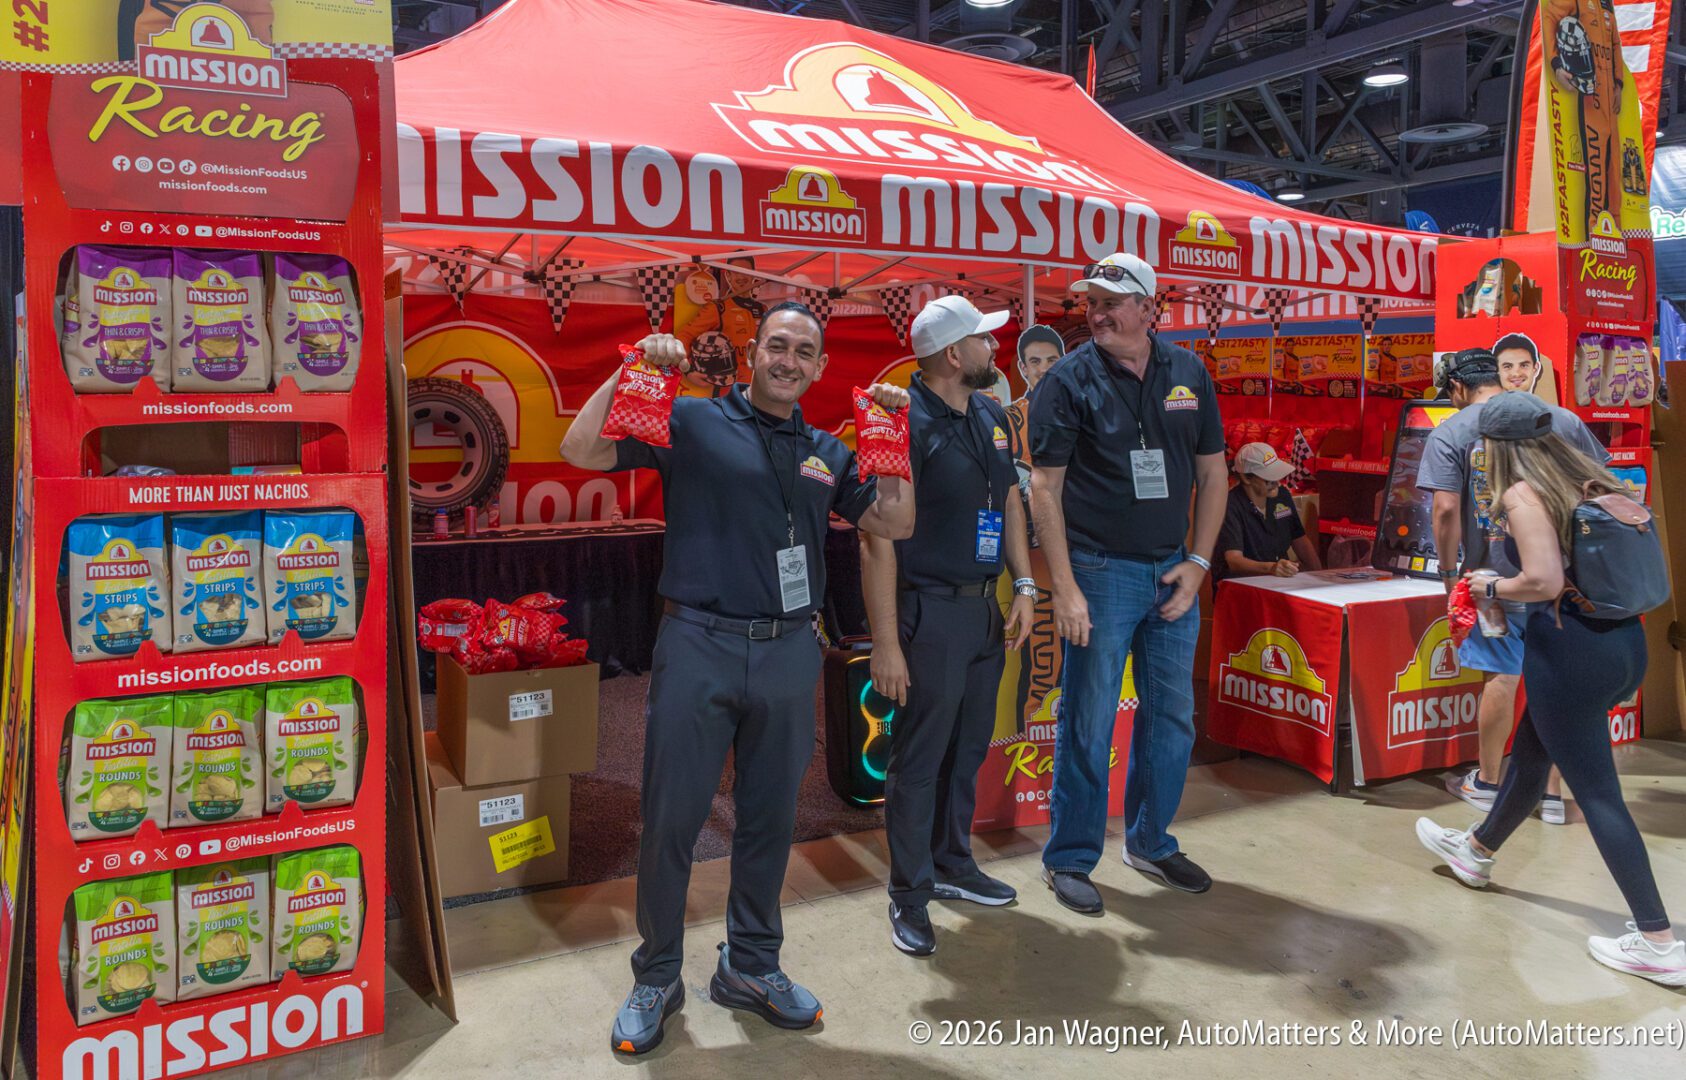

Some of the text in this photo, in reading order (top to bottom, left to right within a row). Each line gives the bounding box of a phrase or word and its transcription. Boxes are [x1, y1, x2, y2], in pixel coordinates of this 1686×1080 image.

[145, 53, 280, 89] MISSION
[88, 76, 326, 162] Racing
[748, 119, 1113, 192] MISSION
[1549, 81, 1570, 238] #2FAST2TASTY
[201, 163, 308, 180] @MissionFoodsUS
[159, 179, 268, 195] missionfoods.com
[765, 207, 862, 236] MISSION
[880, 173, 1159, 267] MISSION
[1447, 222, 1480, 234] CERVEZA
[216, 227, 321, 241] @MissionFoodsUS
[1591, 236, 1626, 254] MISSION
[1172, 245, 1237, 270] MISSION
[1249, 215, 1438, 294] MISSION
[1579, 249, 1638, 291] Racing
[95, 288, 155, 303] MISSION
[188, 289, 247, 303] MISSION
[290, 288, 343, 302] MISSION
[143, 401, 293, 415] missionfoods.com
[1166, 399, 1197, 409] MISSION
[803, 466, 834, 483] MISSION
[129, 487, 171, 504] MORE
[176, 486, 214, 503] THAN
[217, 485, 250, 502] JUST
[188, 552, 249, 570] MISSION
[279, 554, 338, 567] MISSION
[88, 563, 149, 578] MISSION
[204, 582, 236, 594] STRIPS
[294, 581, 325, 592] STRIPS
[104, 593, 138, 604] STRIPS
[117, 656, 322, 688] missionfoods.com
[516, 692, 545, 704] 51123
[1224, 673, 1326, 725] MISSION
[1393, 692, 1482, 736] MISSIO
[280, 717, 339, 734] MISSION
[188, 733, 245, 748] MISSION
[88, 741, 153, 758] MISSION
[291, 747, 329, 757] ROUNDS
[199, 762, 236, 773] ROUNDS
[99, 771, 142, 783] ROUNDS
[486, 797, 516, 809] 51123
[225, 819, 356, 851] @MissionFoodsUS
[193, 886, 253, 906] MISSION
[289, 891, 344, 911] MISSION
[93, 917, 157, 942] MISSION
[204, 916, 244, 932] ROUNDS
[298, 919, 336, 935] ROUNDS
[105, 948, 148, 966] ROUNDS
[62, 984, 363, 1080] MISSION
